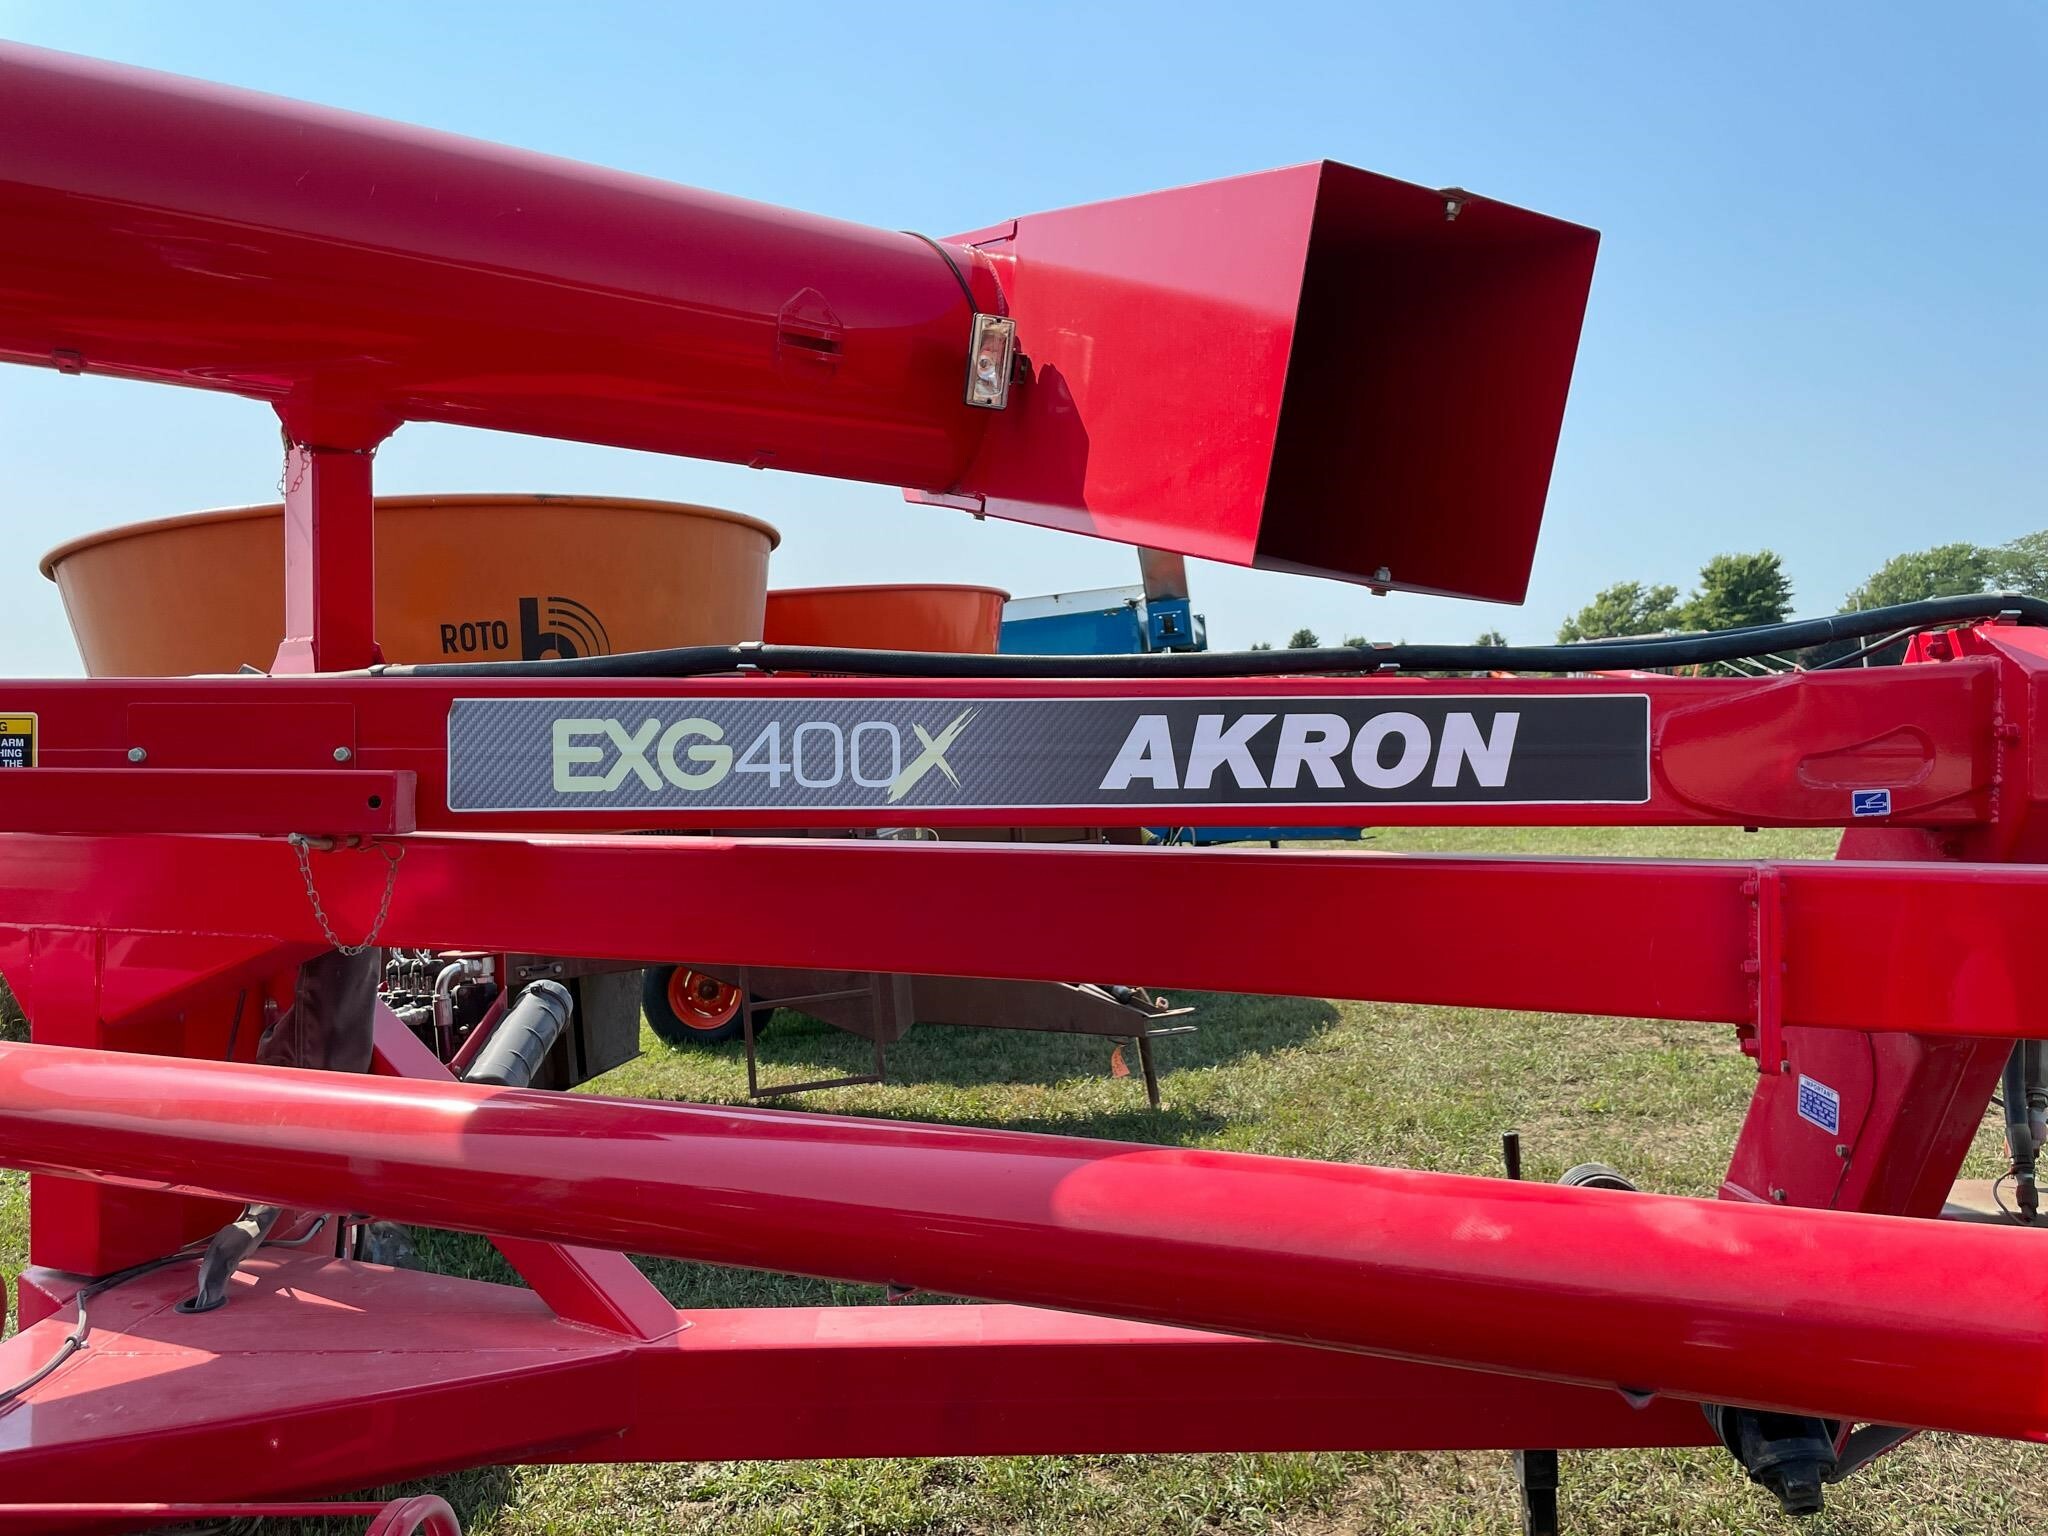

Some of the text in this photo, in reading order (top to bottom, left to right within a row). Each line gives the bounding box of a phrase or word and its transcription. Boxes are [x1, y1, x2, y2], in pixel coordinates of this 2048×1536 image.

[440, 620, 509, 654] ROTO
[1, 738, 24, 747] ARM
[552, 706, 983, 805] EXG400X
[1098, 711, 1521, 790] AKRON
[3, 759, 23, 768] THE
[1804, 1079, 1834, 1099] IMPORTANT
